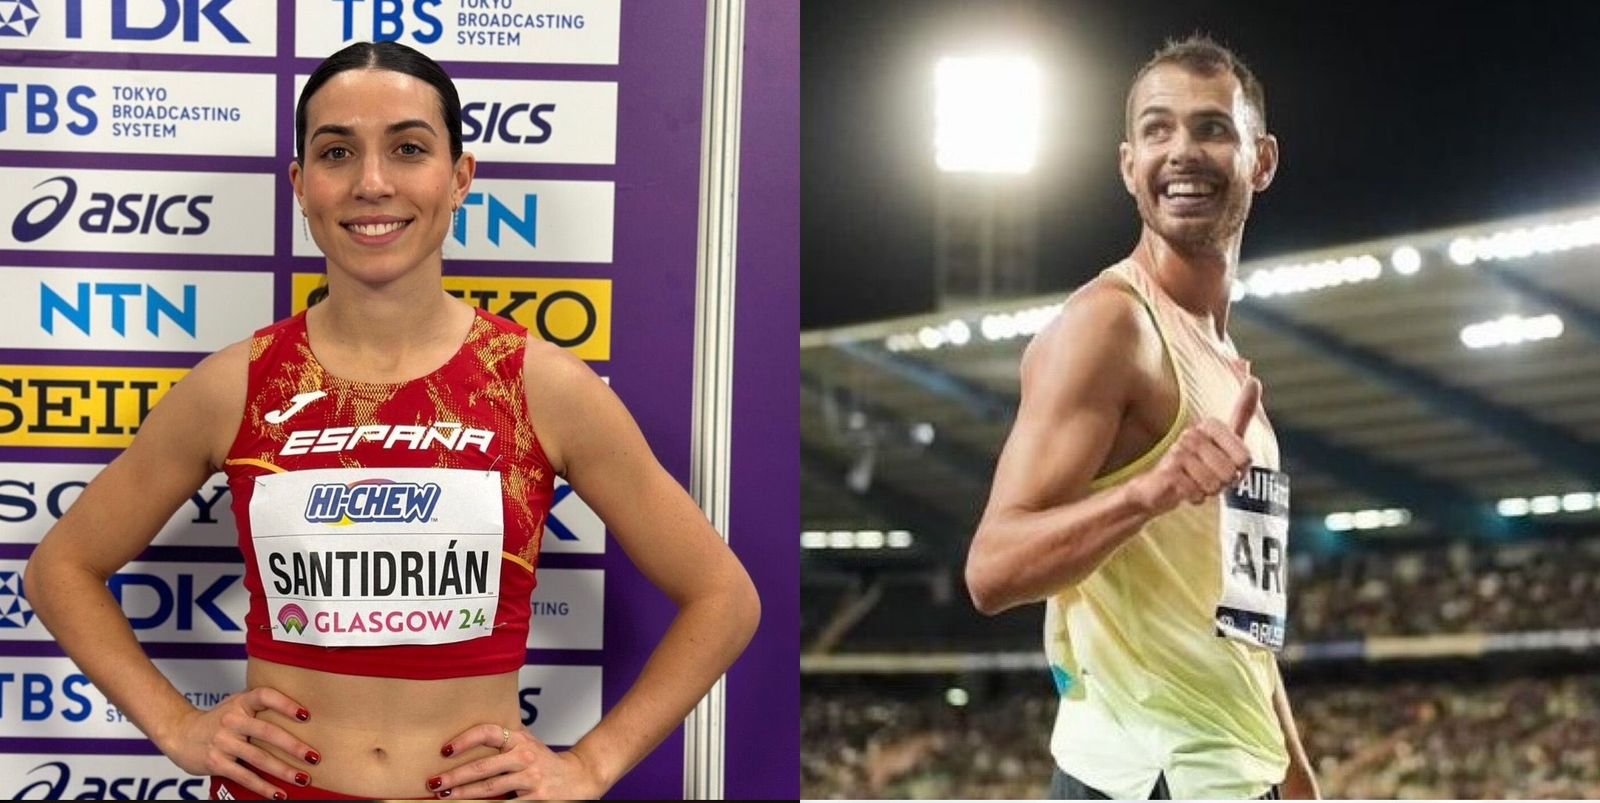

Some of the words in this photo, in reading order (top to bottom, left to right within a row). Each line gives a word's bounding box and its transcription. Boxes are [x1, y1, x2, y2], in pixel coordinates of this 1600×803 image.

[331, 0, 444, 44] TBS
[457, 13, 585, 29] BROADCASTING
[457, 31, 521, 46] SYSTEM
[112, 86, 167, 101] TOKYO
[112, 105, 241, 122] BROADCASTING
[112, 123, 177, 138] SYSTEM
[461, 102, 556, 144] SICS
[453, 192, 537, 248] TN
[40, 281, 196, 339] NTN
[279, 421, 495, 456] ESPAÑA
[305, 482, 441, 523] HI-CHEW
[268, 540, 489, 597] SANTIDRIÁN
[106, 573, 243, 631] DK
[314, 610, 453, 633] GLASGOW
[458, 608, 486, 629] 24
